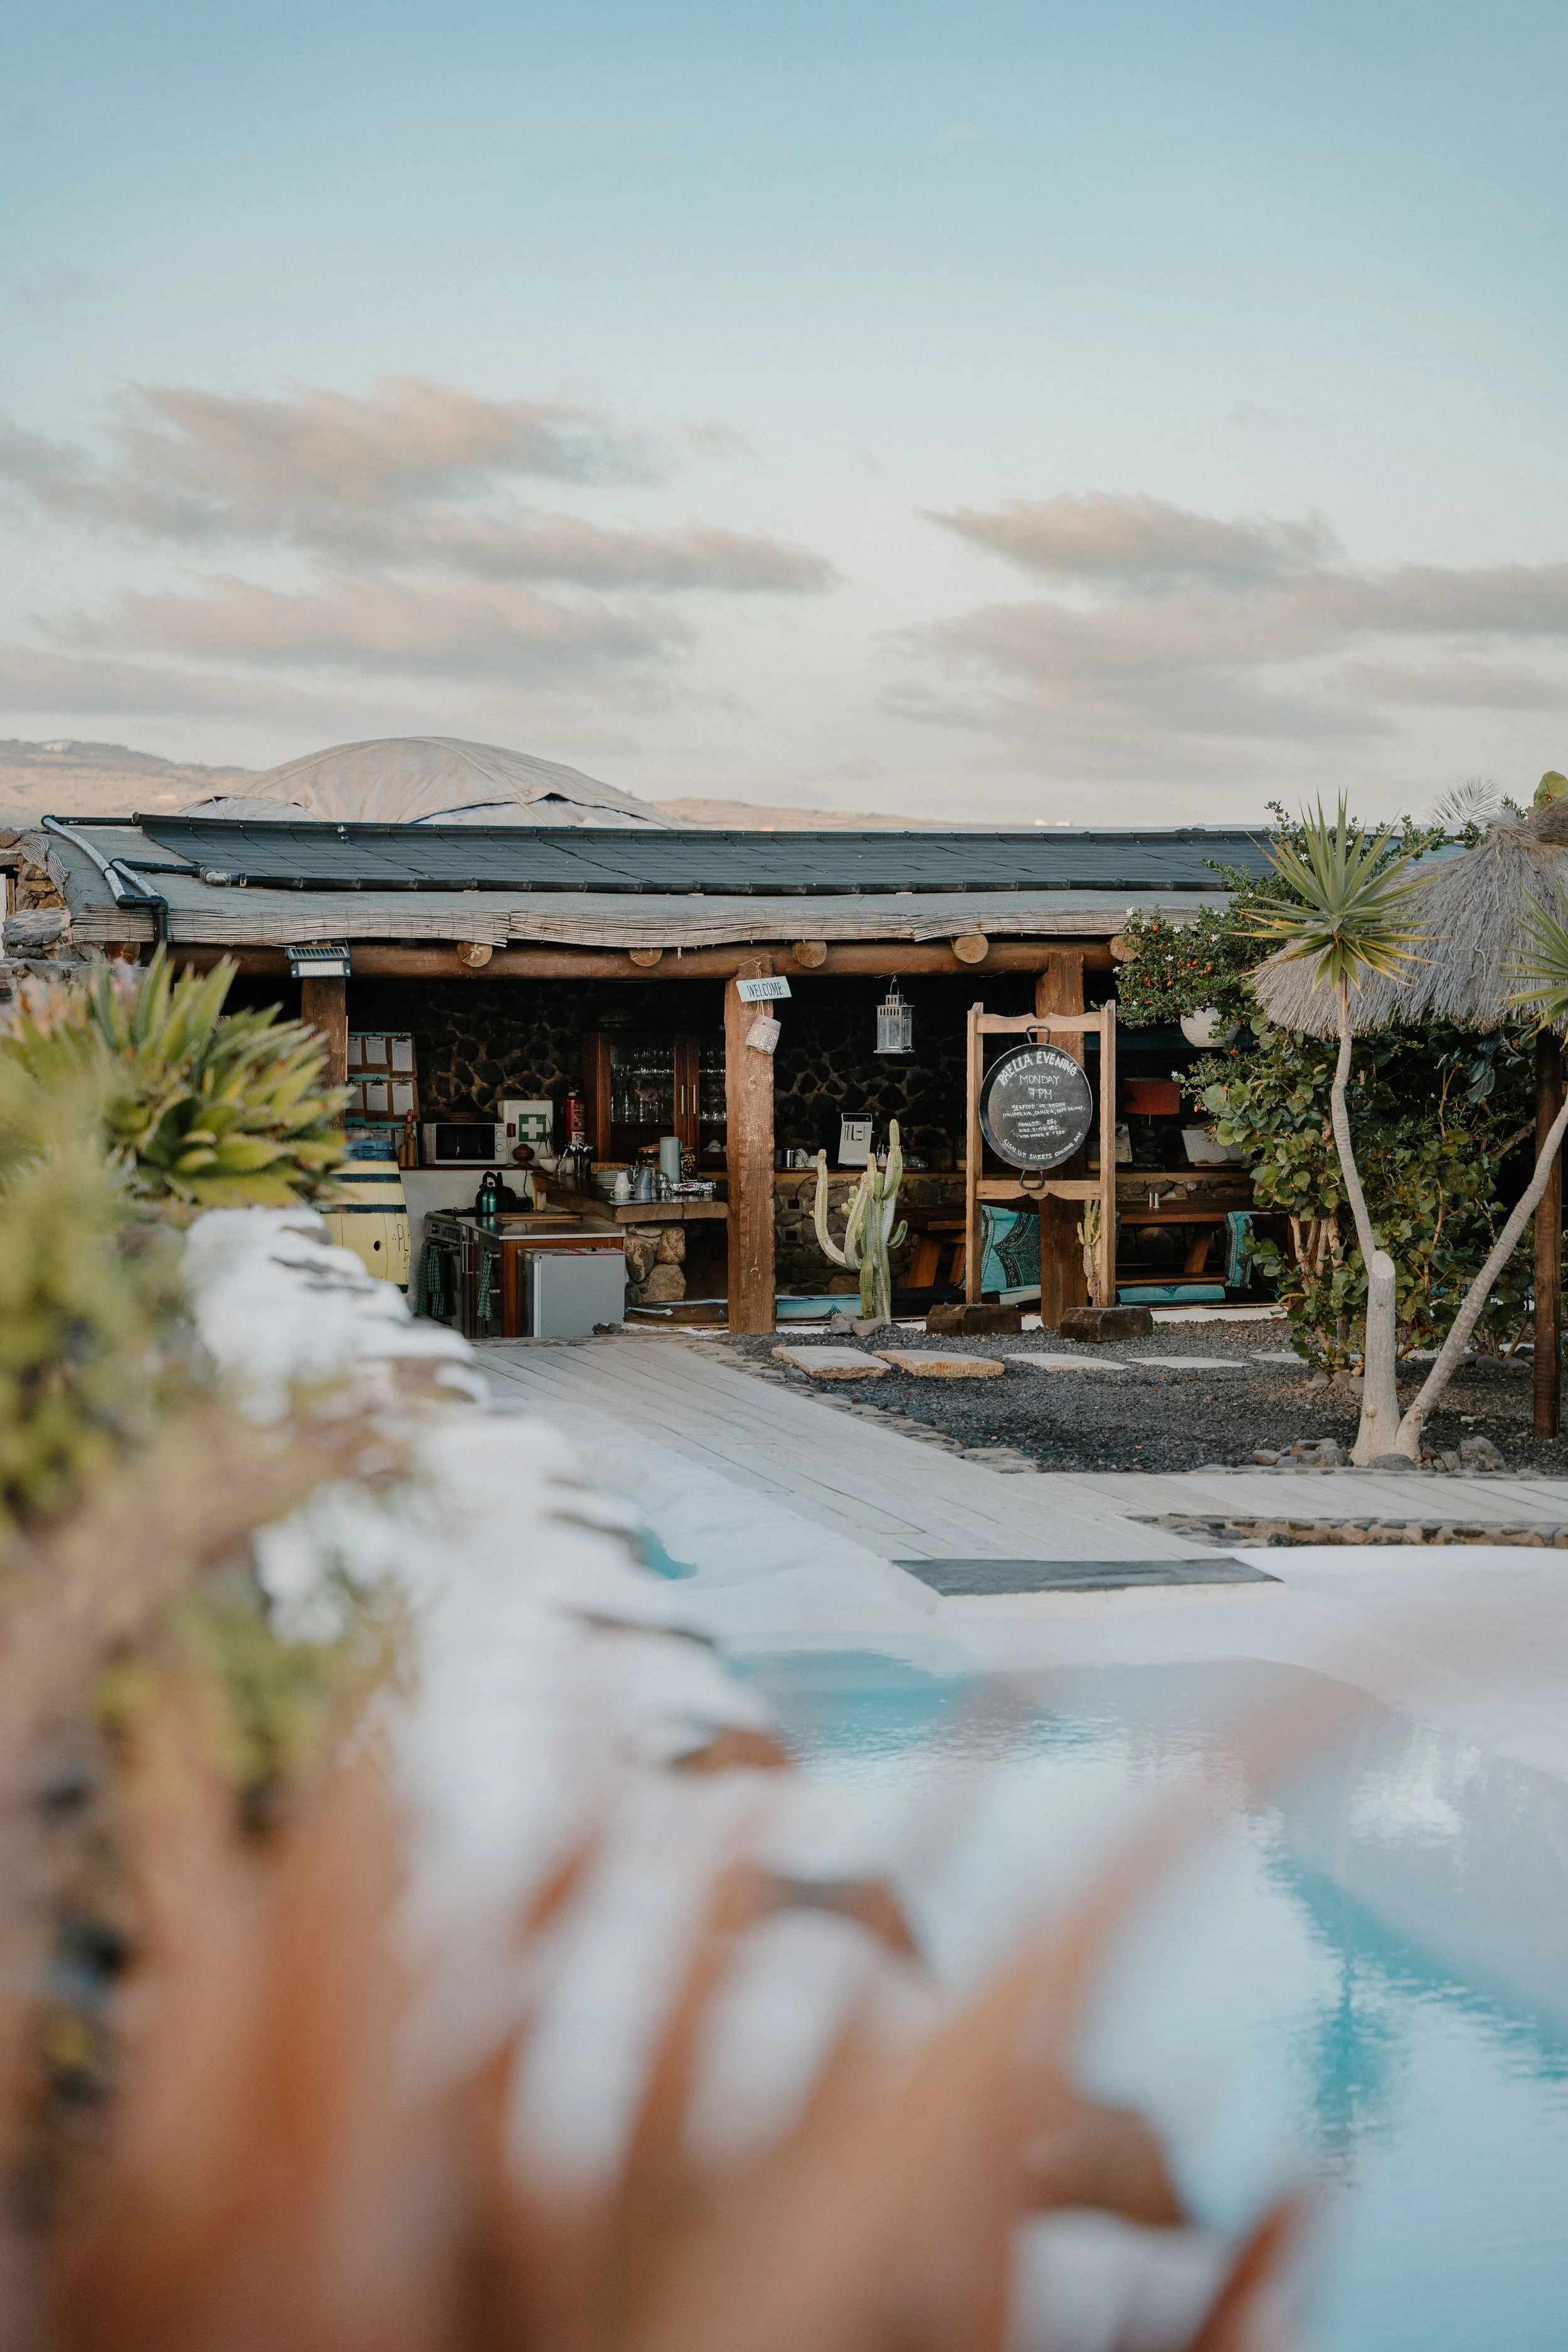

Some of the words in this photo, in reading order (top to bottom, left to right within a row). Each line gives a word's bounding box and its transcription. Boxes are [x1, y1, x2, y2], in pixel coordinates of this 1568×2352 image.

[746, 982, 783, 998] WELCOME
[997, 1053, 1033, 1086] PAELLA
[1036, 1051, 1077, 1077] EVENING
[1019, 1074, 1059, 1086] MONDAY
[1029, 1088, 1035, 1099] 7
[1038, 1088, 1052, 1099] PM
[1012, 1104, 1036, 1112] SEAFOOD
[1002, 1139, 1016, 1153] SIGN
[1017, 1149, 1027, 1158] UP
[1064, 1142, 1074, 1152] THE
[1073, 1131, 1084, 1142] BAR
